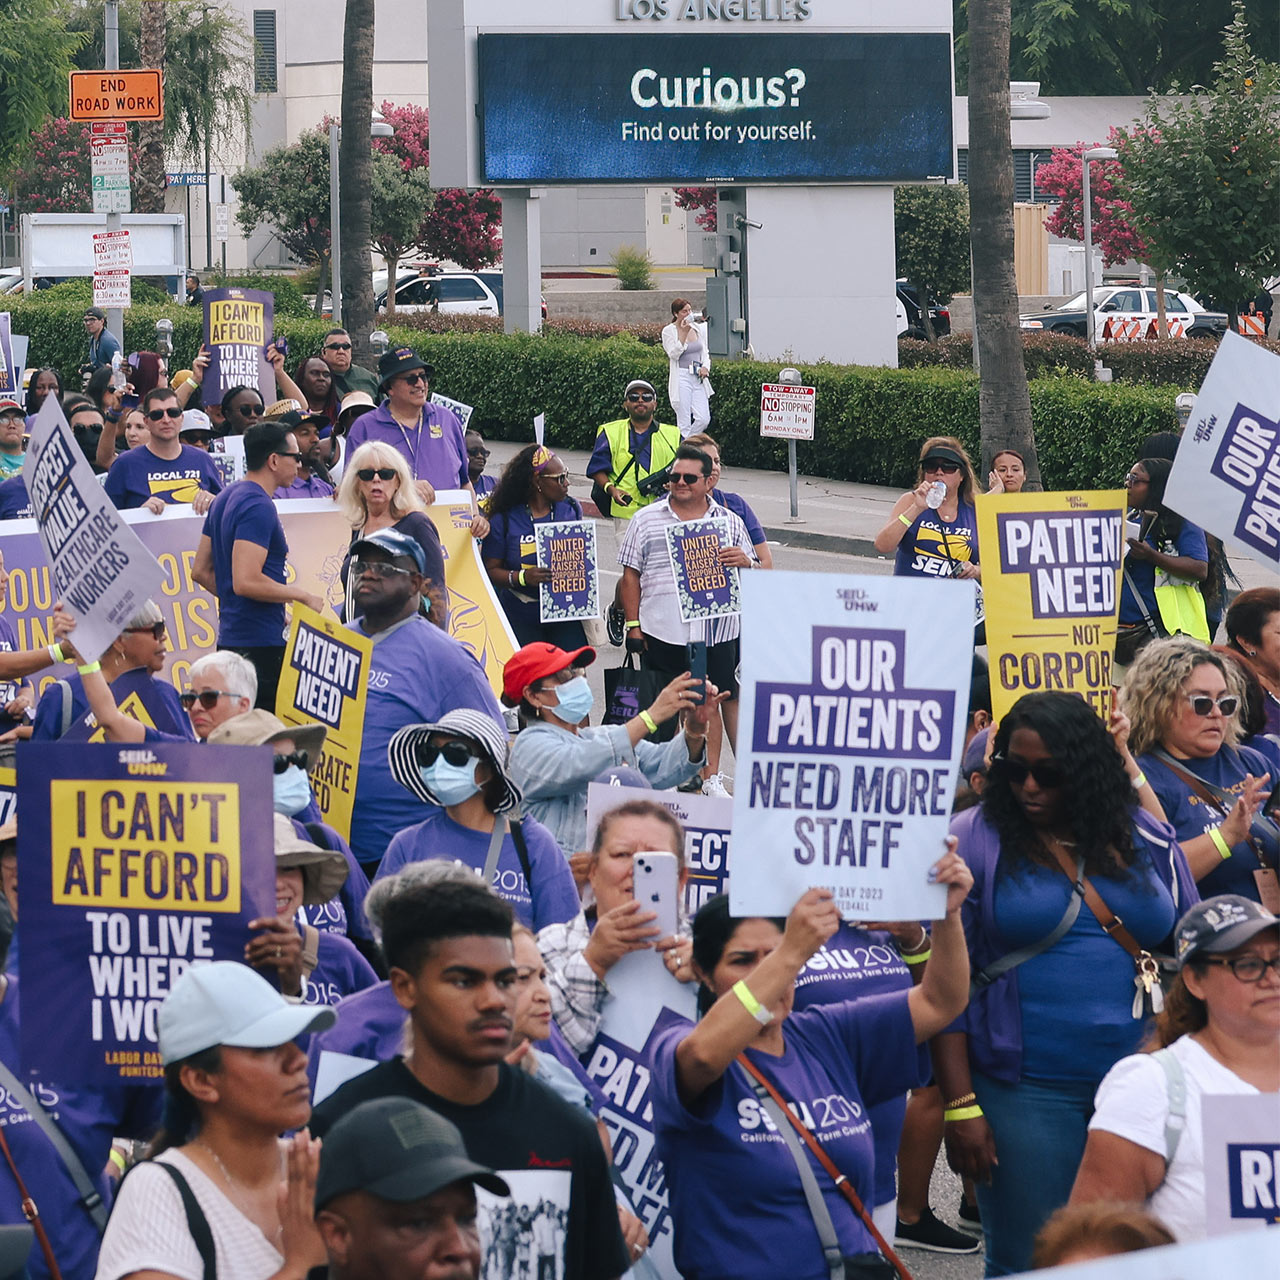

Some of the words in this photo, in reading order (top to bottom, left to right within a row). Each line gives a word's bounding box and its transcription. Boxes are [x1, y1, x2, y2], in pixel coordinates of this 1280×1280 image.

[101, 80, 125, 91] END
[631, 68, 806, 108] Curious?
[77, 98, 109, 111] ROAD
[116, 97, 155, 110] WORK
[622, 122, 662, 140] Find
[669, 124, 699, 140] out
[705, 122, 731, 140] for
[737, 122, 816, 144] yourself.
[92, 146, 103, 155] NO
[95, 176, 102, 186] 2
[106, 179, 127, 188] PARKING
[170, 174, 186, 184] PAY
[188, 174, 207, 184] HERE
[95, 244, 106, 252] NO
[108, 242, 130, 251] STOPPING
[95, 281, 106, 289] NO
[216, 305, 220, 320] I
[224, 303, 260, 320] CAN'T
[213, 323, 261, 342] AFFORD
[219, 345, 233, 359] TO
[236, 346, 258, 360] LIVE
[220, 360, 258, 375] WHERE
[220, 375, 224, 390] I
[226, 375, 258, 390] WORK
[765, 400, 779, 410] NO
[781, 402, 811, 413] STOPPING
[768, 413, 783, 422] 6AM
[795, 415, 807, 424] 1PM
[148, 472, 182, 480] LOCAL
[185, 471, 200, 479] 721
[681, 535, 718, 551] UNITED
[1005, 517, 1122, 565] PATIENT
[684, 547, 721, 560] AGAINST
[686, 557, 722, 569] KAISER'S
[687, 567, 724, 579] CORPORATE
[689, 575, 726, 592] GREED
[1037, 567, 1114, 613] NEED
[1073, 625, 1100, 645] NOT
[294, 627, 360, 691] PATIENT
[820, 637, 896, 692] OUR
[296, 671, 341, 723] NEED
[767, 693, 942, 752] PATIENTS
[749, 761, 839, 810] NEED
[851, 765, 949, 815] MORE
[794, 816, 903, 868] STAFF
